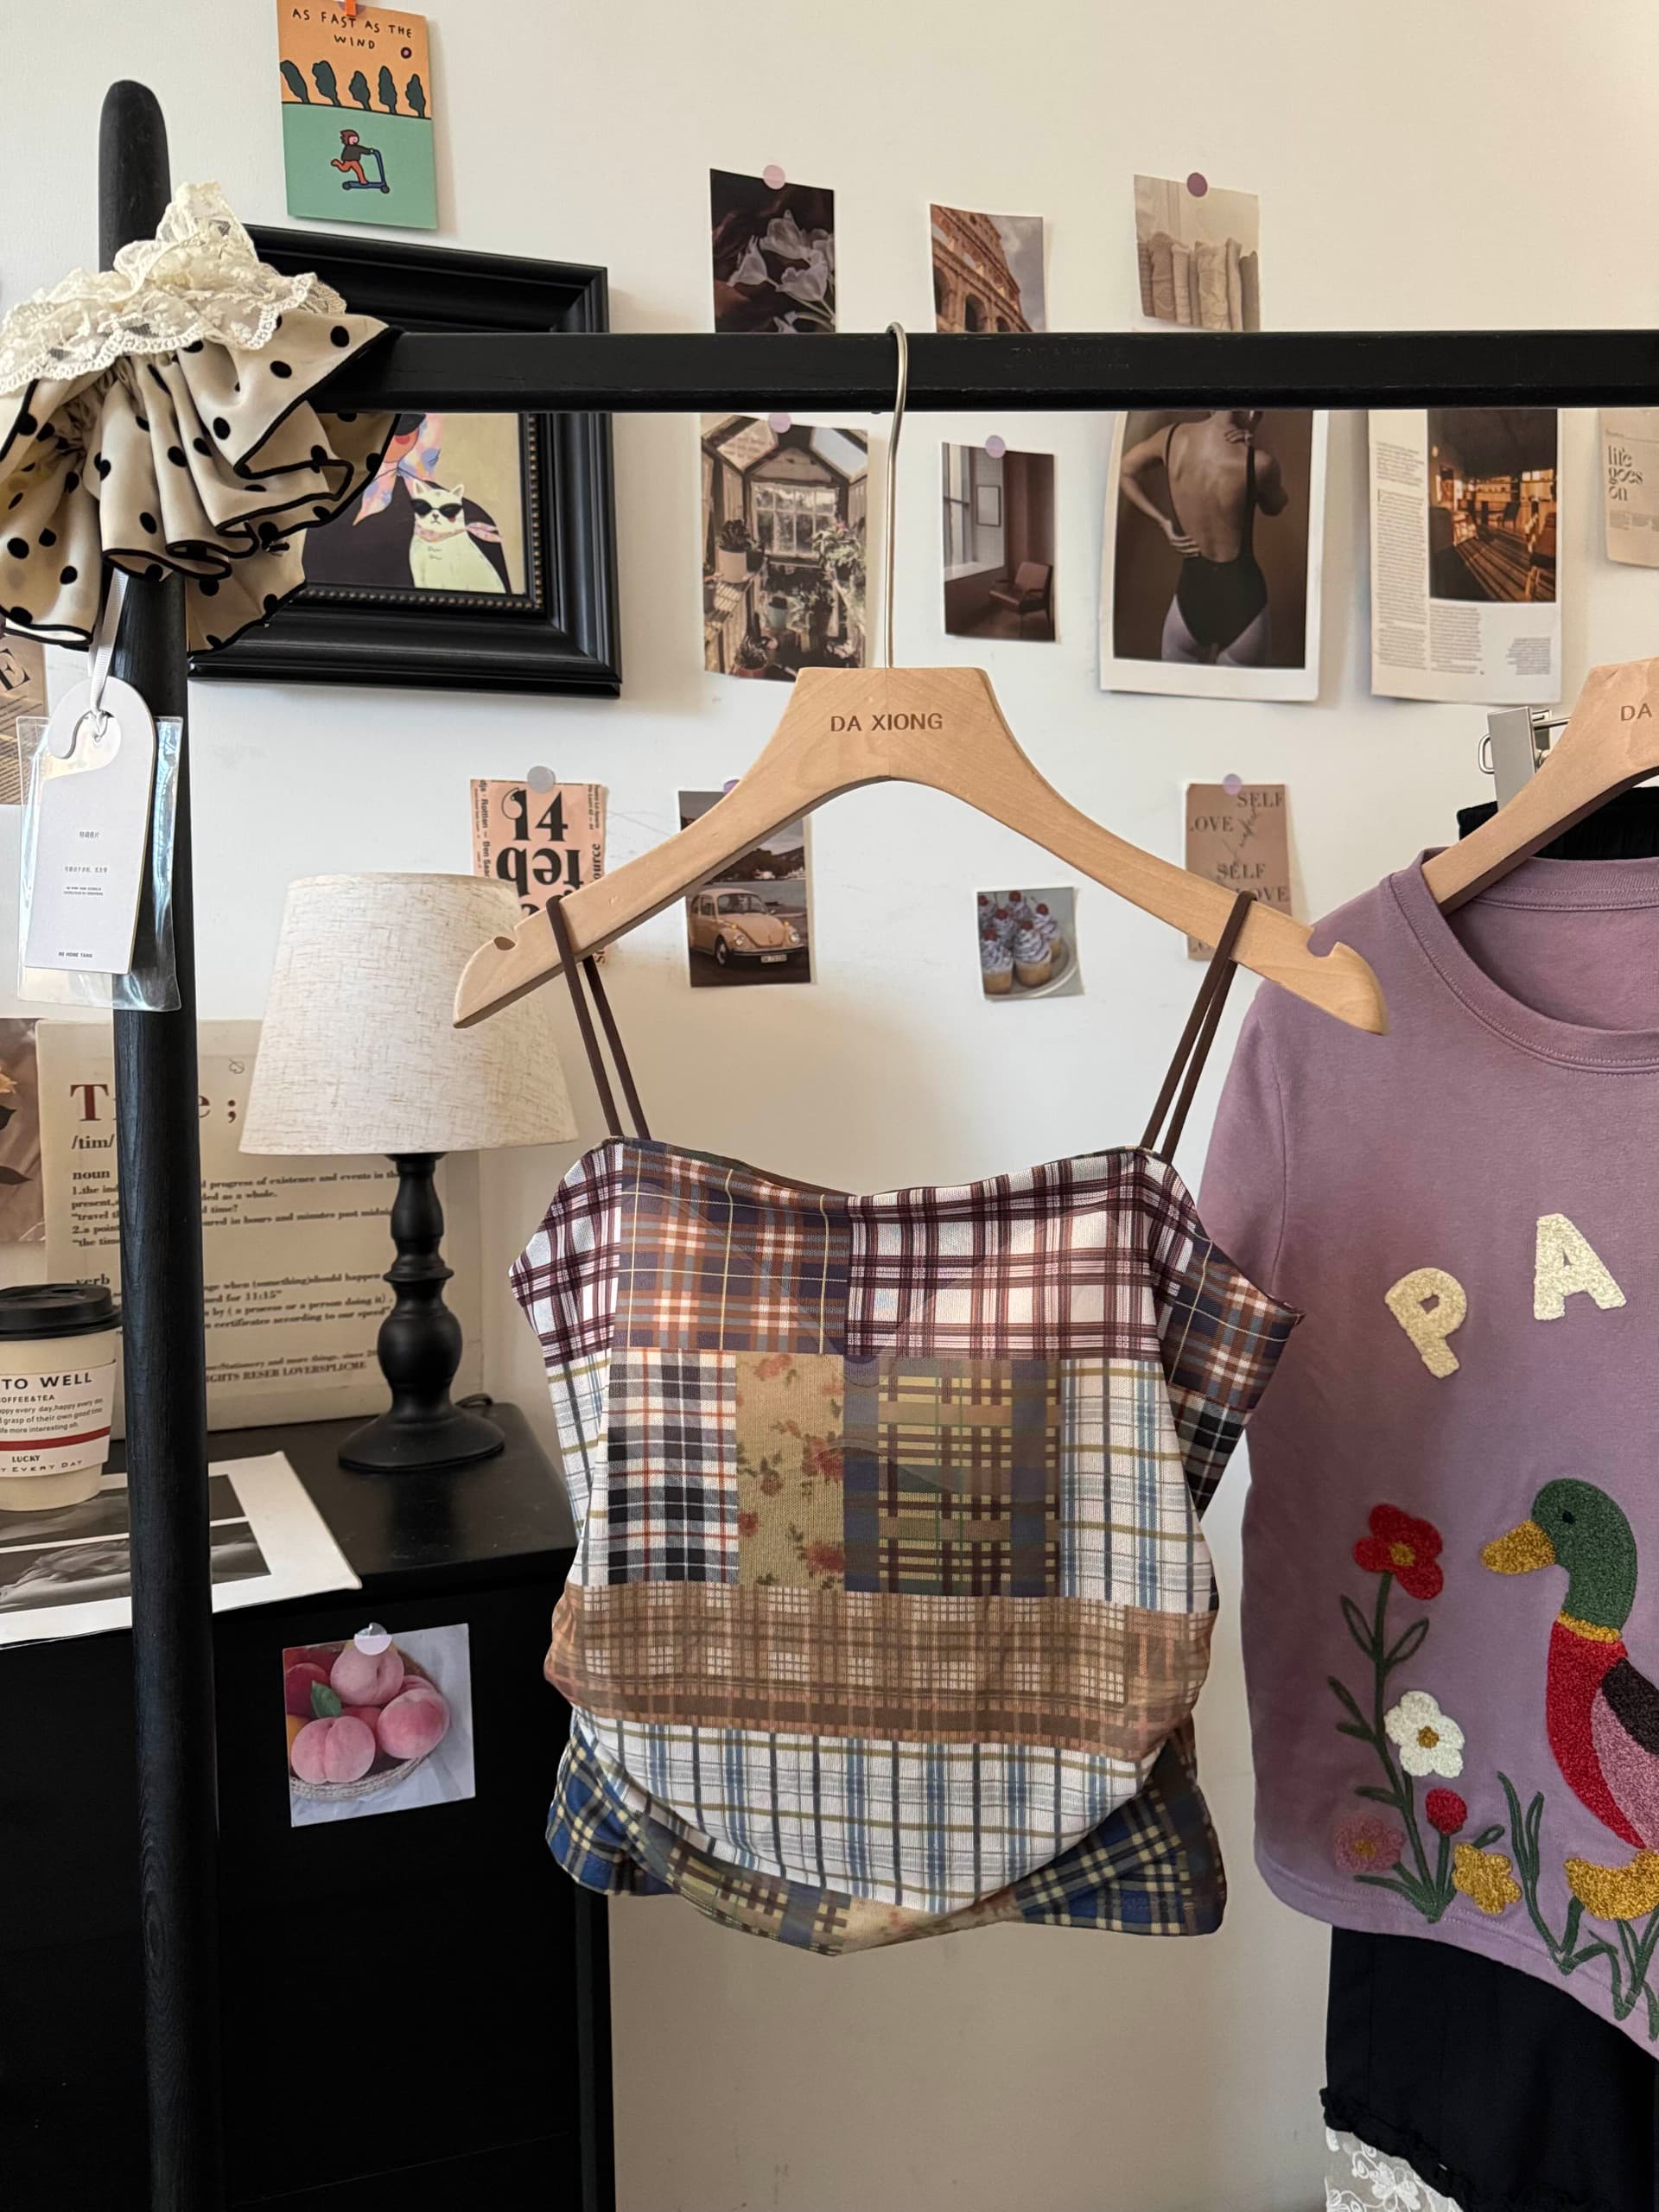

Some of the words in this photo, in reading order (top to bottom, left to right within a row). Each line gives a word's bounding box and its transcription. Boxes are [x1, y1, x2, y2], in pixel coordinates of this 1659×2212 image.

[292, 9, 310, 20] AS
[321, 11, 356, 29] FAST
[365, 21, 380, 33] AS
[389, 25, 412, 38] THE
[334, 35, 375, 49] WIND
[1608, 446, 1632, 467] life
[1608, 467, 1643, 485] goes
[1608, 486, 1628, 501] on
[1621, 702, 1653, 721] DA
[830, 715, 861, 732] DA
[871, 713, 943, 731] XIONG
[1237, 791, 1284, 808] SELF
[501, 787, 569, 842] 14
[1188, 816, 1233, 832] OVE
[591, 843, 602, 880] ource
[1216, 864, 1265, 880] SELF
[71, 1134, 115, 1150] /tim/
[73, 1171, 110, 1180] noun
[2, 1378, 28, 1389] TO
[40, 1372, 92, 1388] WELL
[0, 1394, 54, 1403] OFFEE&TEA
